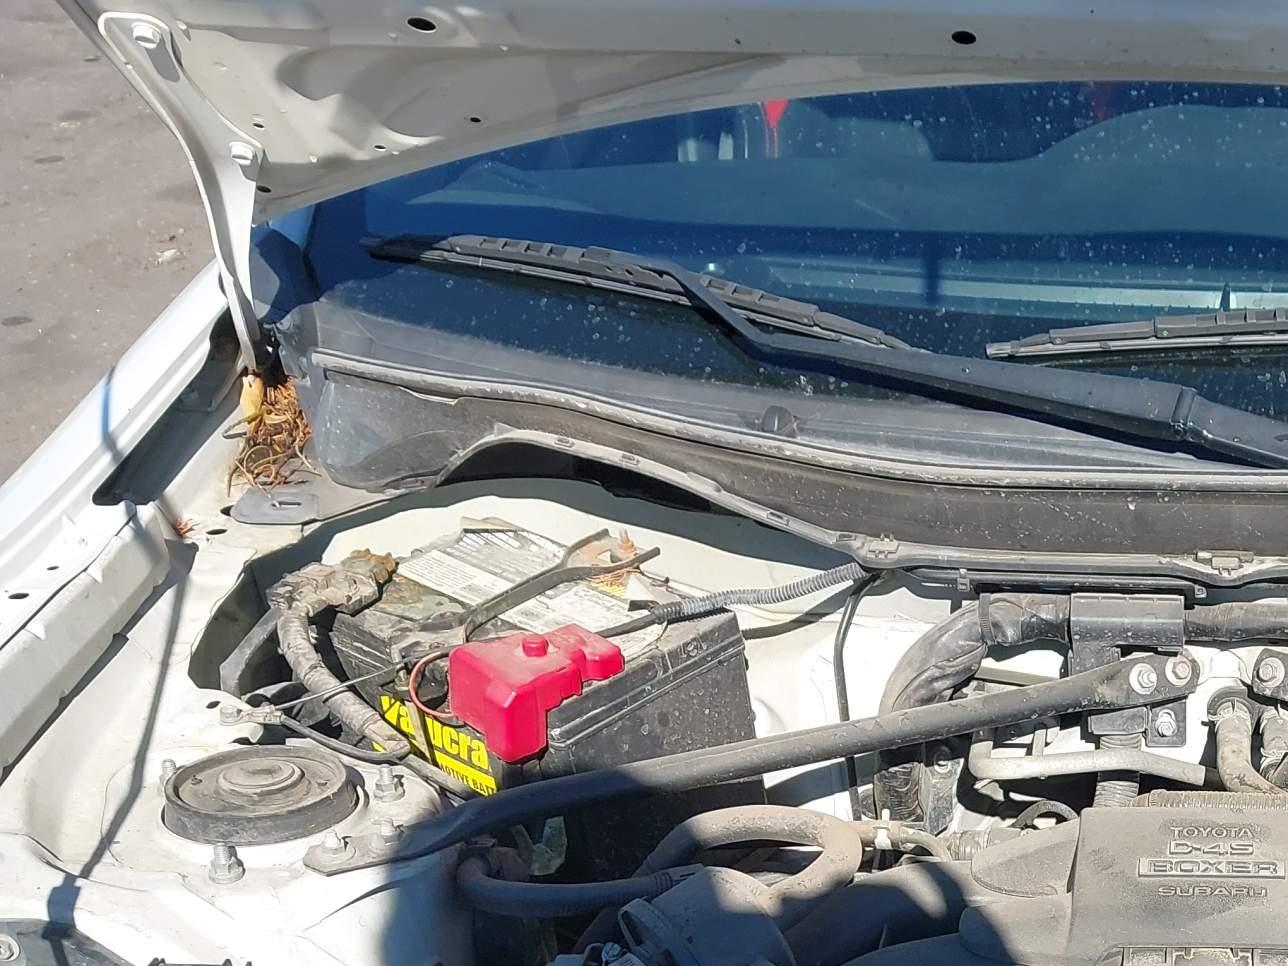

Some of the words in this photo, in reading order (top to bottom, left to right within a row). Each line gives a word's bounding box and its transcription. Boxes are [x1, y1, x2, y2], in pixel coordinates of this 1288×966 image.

[1170, 826, 1254, 839] TOYOTA
[1168, 841, 1254, 856] D-4S
[1148, 860, 1279, 875] BOXER
[1157, 886, 1267, 898] SUBARU
